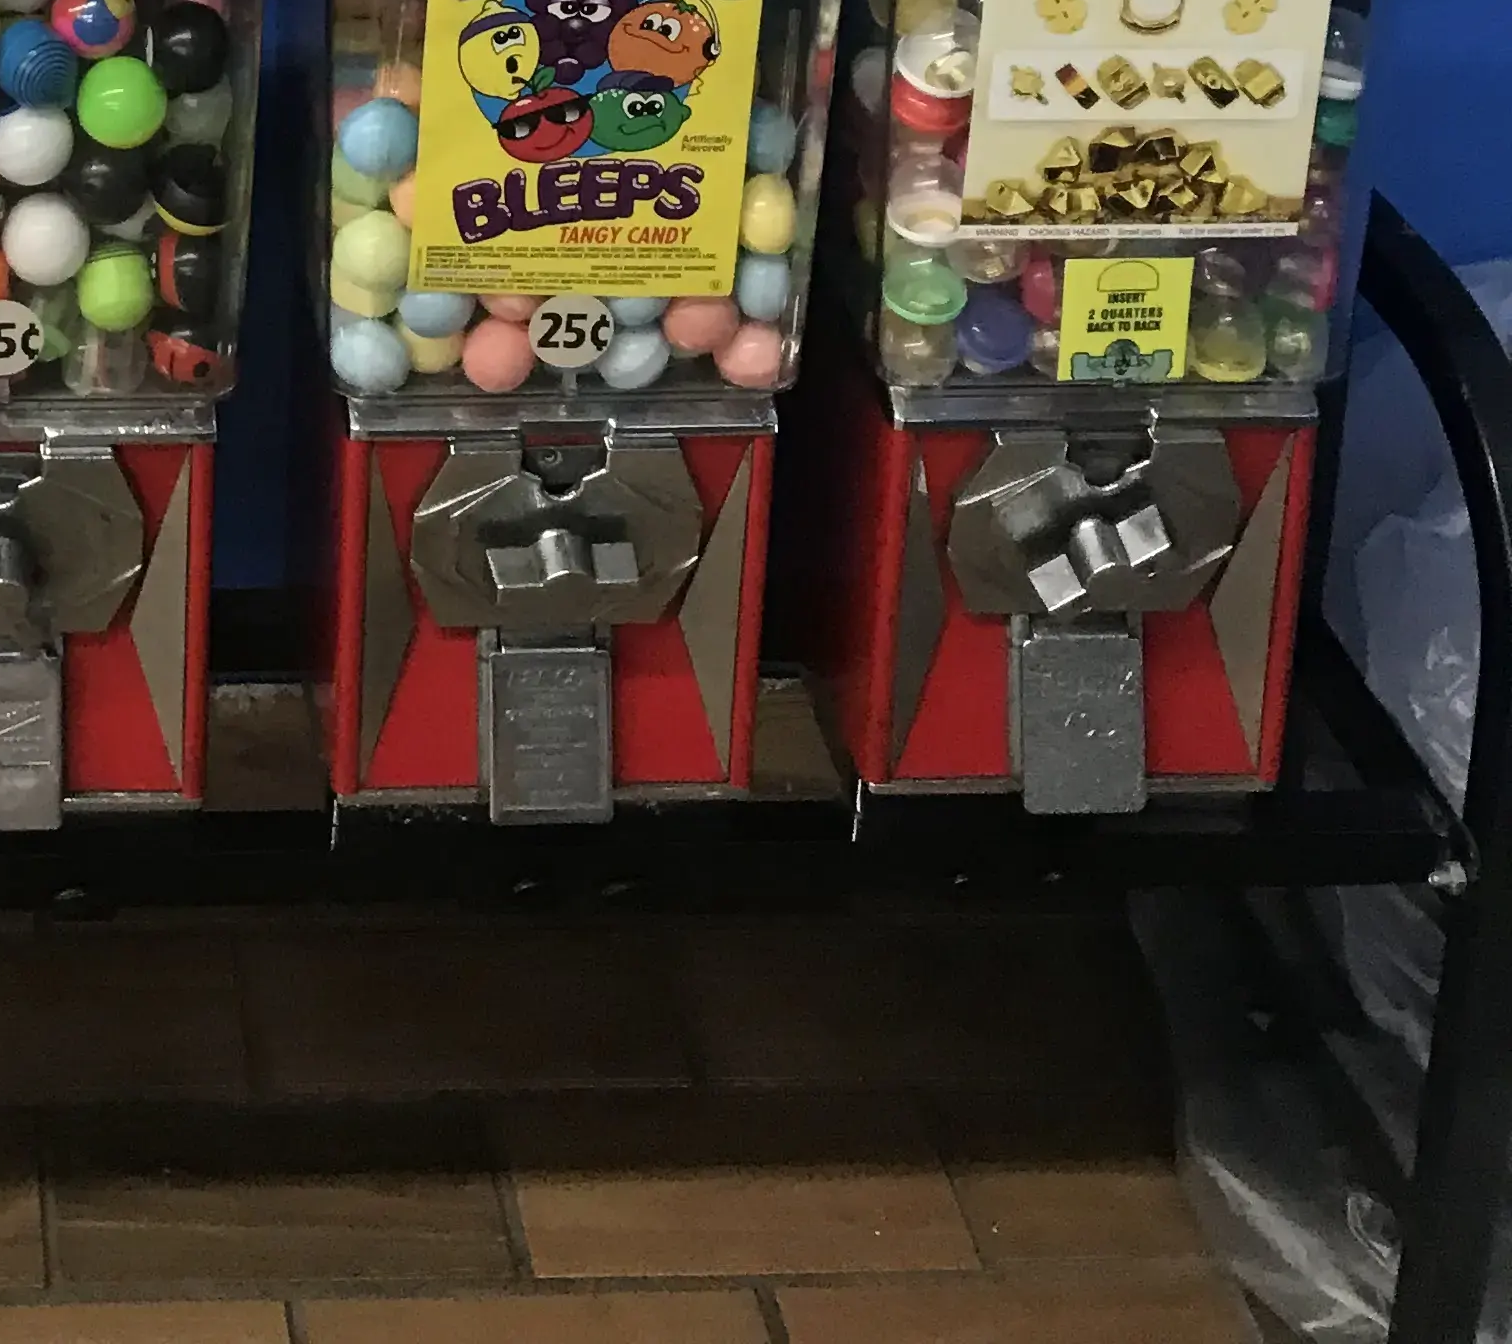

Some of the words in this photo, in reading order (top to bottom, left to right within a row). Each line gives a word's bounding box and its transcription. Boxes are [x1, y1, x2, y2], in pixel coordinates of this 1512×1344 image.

[452, 158, 706, 245] BLEEPS
[559, 225, 623, 245] TANGY
[627, 225, 693, 245] CANDY
[1108, 292, 1146, 304] INSERT
[1088, 309, 1095, 320] 2
[1100, 307, 1163, 320] QUARTERS
[536, 312, 610, 351] 25¢
[1086, 321, 1115, 333] BACK
[1118, 321, 1131, 332] TO
[1134, 320, 1162, 331] BACK
